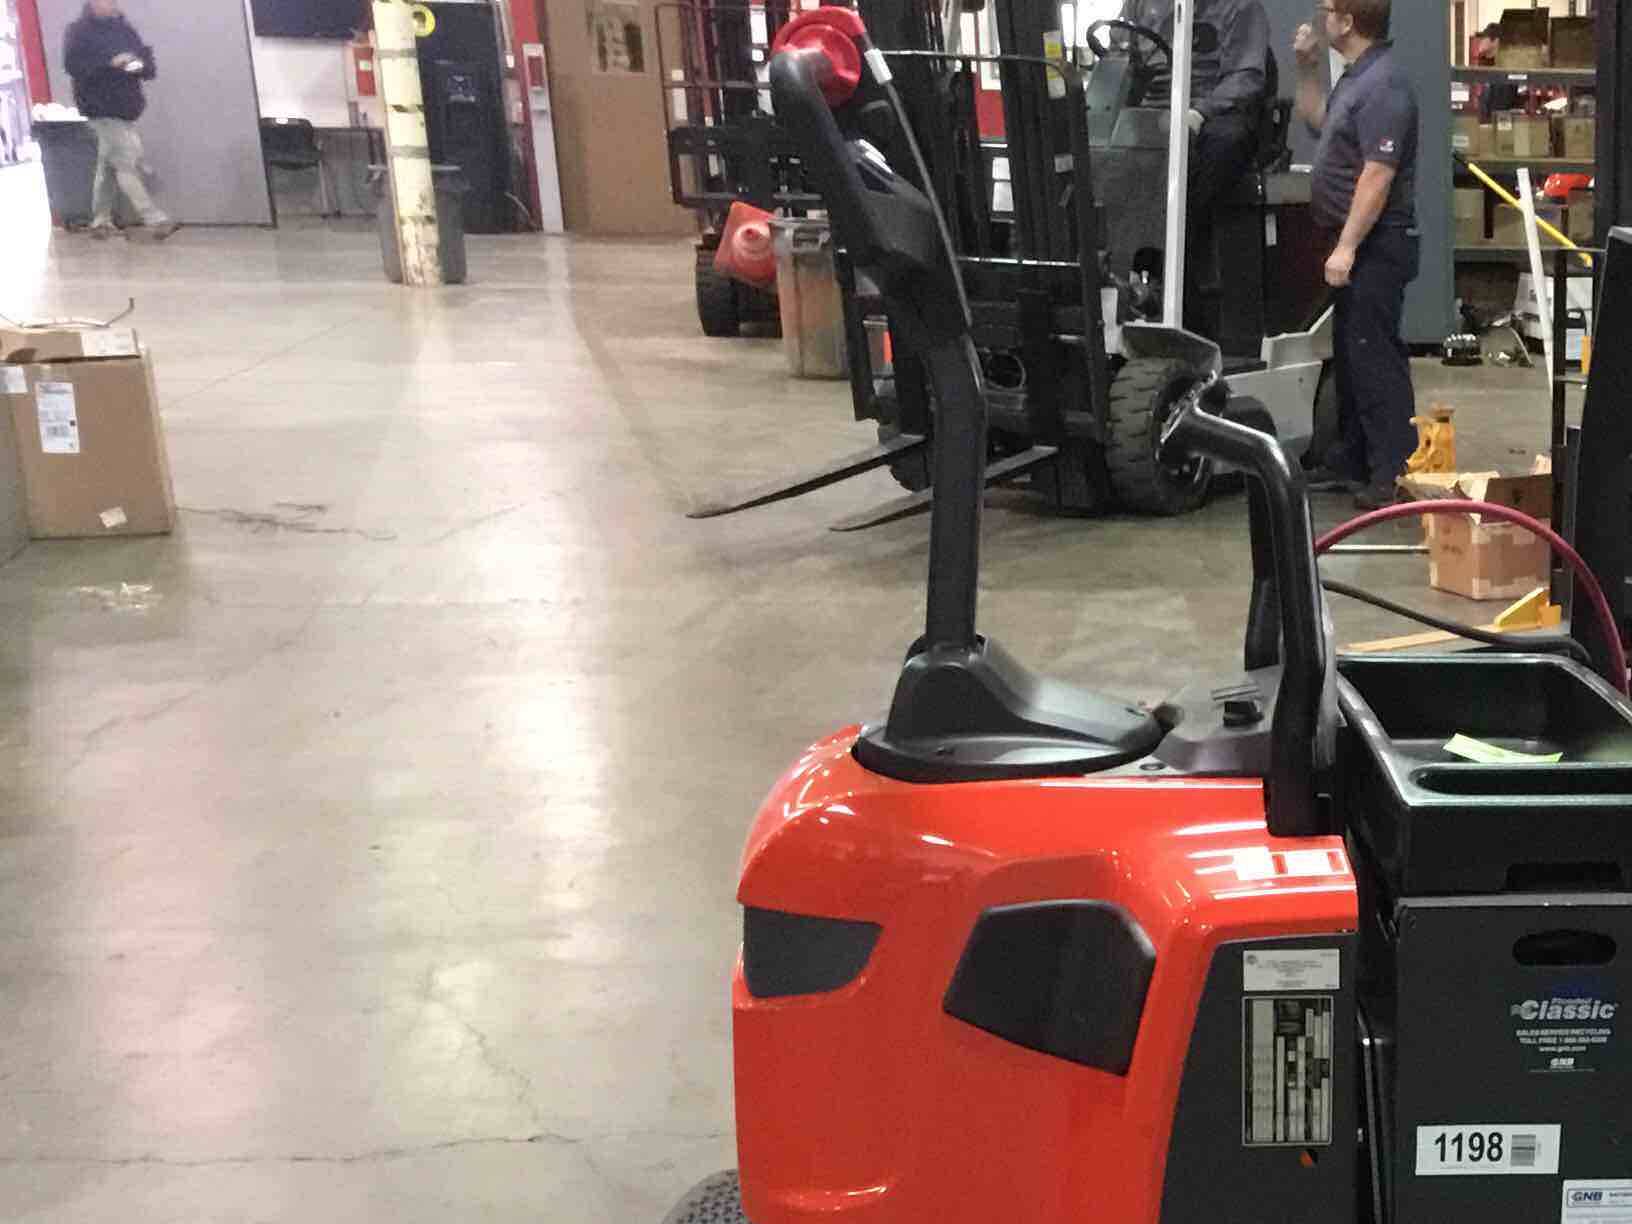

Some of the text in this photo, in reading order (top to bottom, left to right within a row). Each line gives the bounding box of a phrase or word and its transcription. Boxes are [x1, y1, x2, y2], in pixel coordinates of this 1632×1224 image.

[1520, 999, 1615, 1020] Classic
[1434, 1131, 1503, 1162] 1198
[1571, 1191, 1603, 1201] GNB
